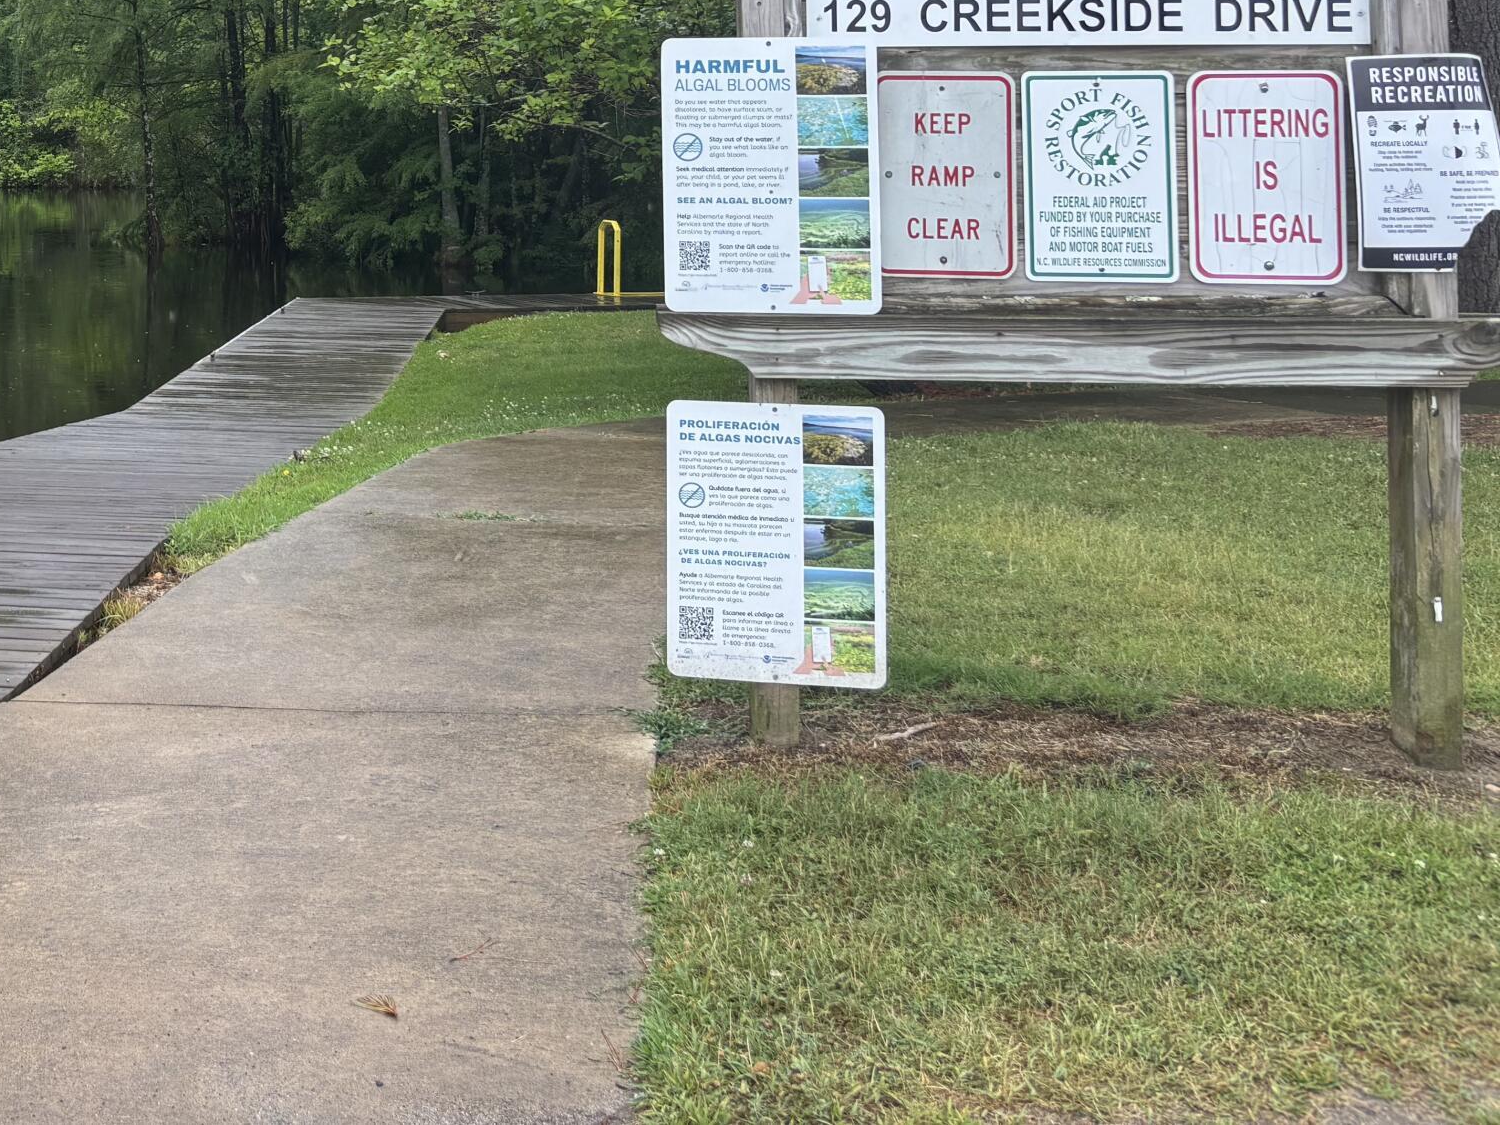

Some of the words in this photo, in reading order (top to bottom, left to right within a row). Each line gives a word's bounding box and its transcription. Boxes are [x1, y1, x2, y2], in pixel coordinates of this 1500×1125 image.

[824, 0, 892, 32] 129
[676, 60, 785, 73] HARMFUL
[1369, 66, 1480, 82] RESPONSIBLE
[675, 78, 723, 91] ALGAL
[728, 78, 791, 91] BLOOMS
[1371, 86, 1482, 103] RECREATION
[1046, 88, 1102, 131] SPORT
[1110, 92, 1150, 129] FISH
[914, 112, 971, 134] KEEP
[1203, 108, 1328, 138] LITTERING
[1044, 134, 1152, 187] RESTORATION
[911, 165, 974, 187] RAMP
[1256, 161, 1278, 190] IS
[1053, 196, 1090, 208] FEDERAL
[1093, 196, 1107, 208] AID
[1110, 196, 1147, 208] PROJECT
[1039, 211, 1074, 222] FUNDED
[1077, 211, 1086, 222] BY
[1089, 211, 1112, 223] YOUR
[1115, 212, 1161, 223] PURCHASE
[907, 218, 980, 240] CLEAR
[1050, 226, 1061, 237] OF
[1064, 226, 1098, 237] FISHING
[1101, 227, 1151, 238] EQUIPMENT
[1215, 214, 1322, 243] ILLEGAL
[1049, 241, 1066, 252] AND
[1069, 241, 1099, 252] MOTOR
[1102, 242, 1122, 252] BOAT
[1126, 242, 1153, 253] FUELS
[1036, 257, 1050, 266] N.C.
[1052, 258, 1081, 266] WILDLIFE
[1084, 258, 1121, 266] RESOURCES
[1124, 258, 1166, 267] COMMISSION
[1393, 253, 1458, 261] NCWILDLIFE.OR
[679, 420, 779, 431] PROLIFERACIÓN
[699, 434, 740, 442] ALGAS
[745, 435, 801, 445] NOCIVAS
[722, 550, 790, 559] PROLIFERACIÓN
[725, 559, 767, 567] NOCIVAS?
